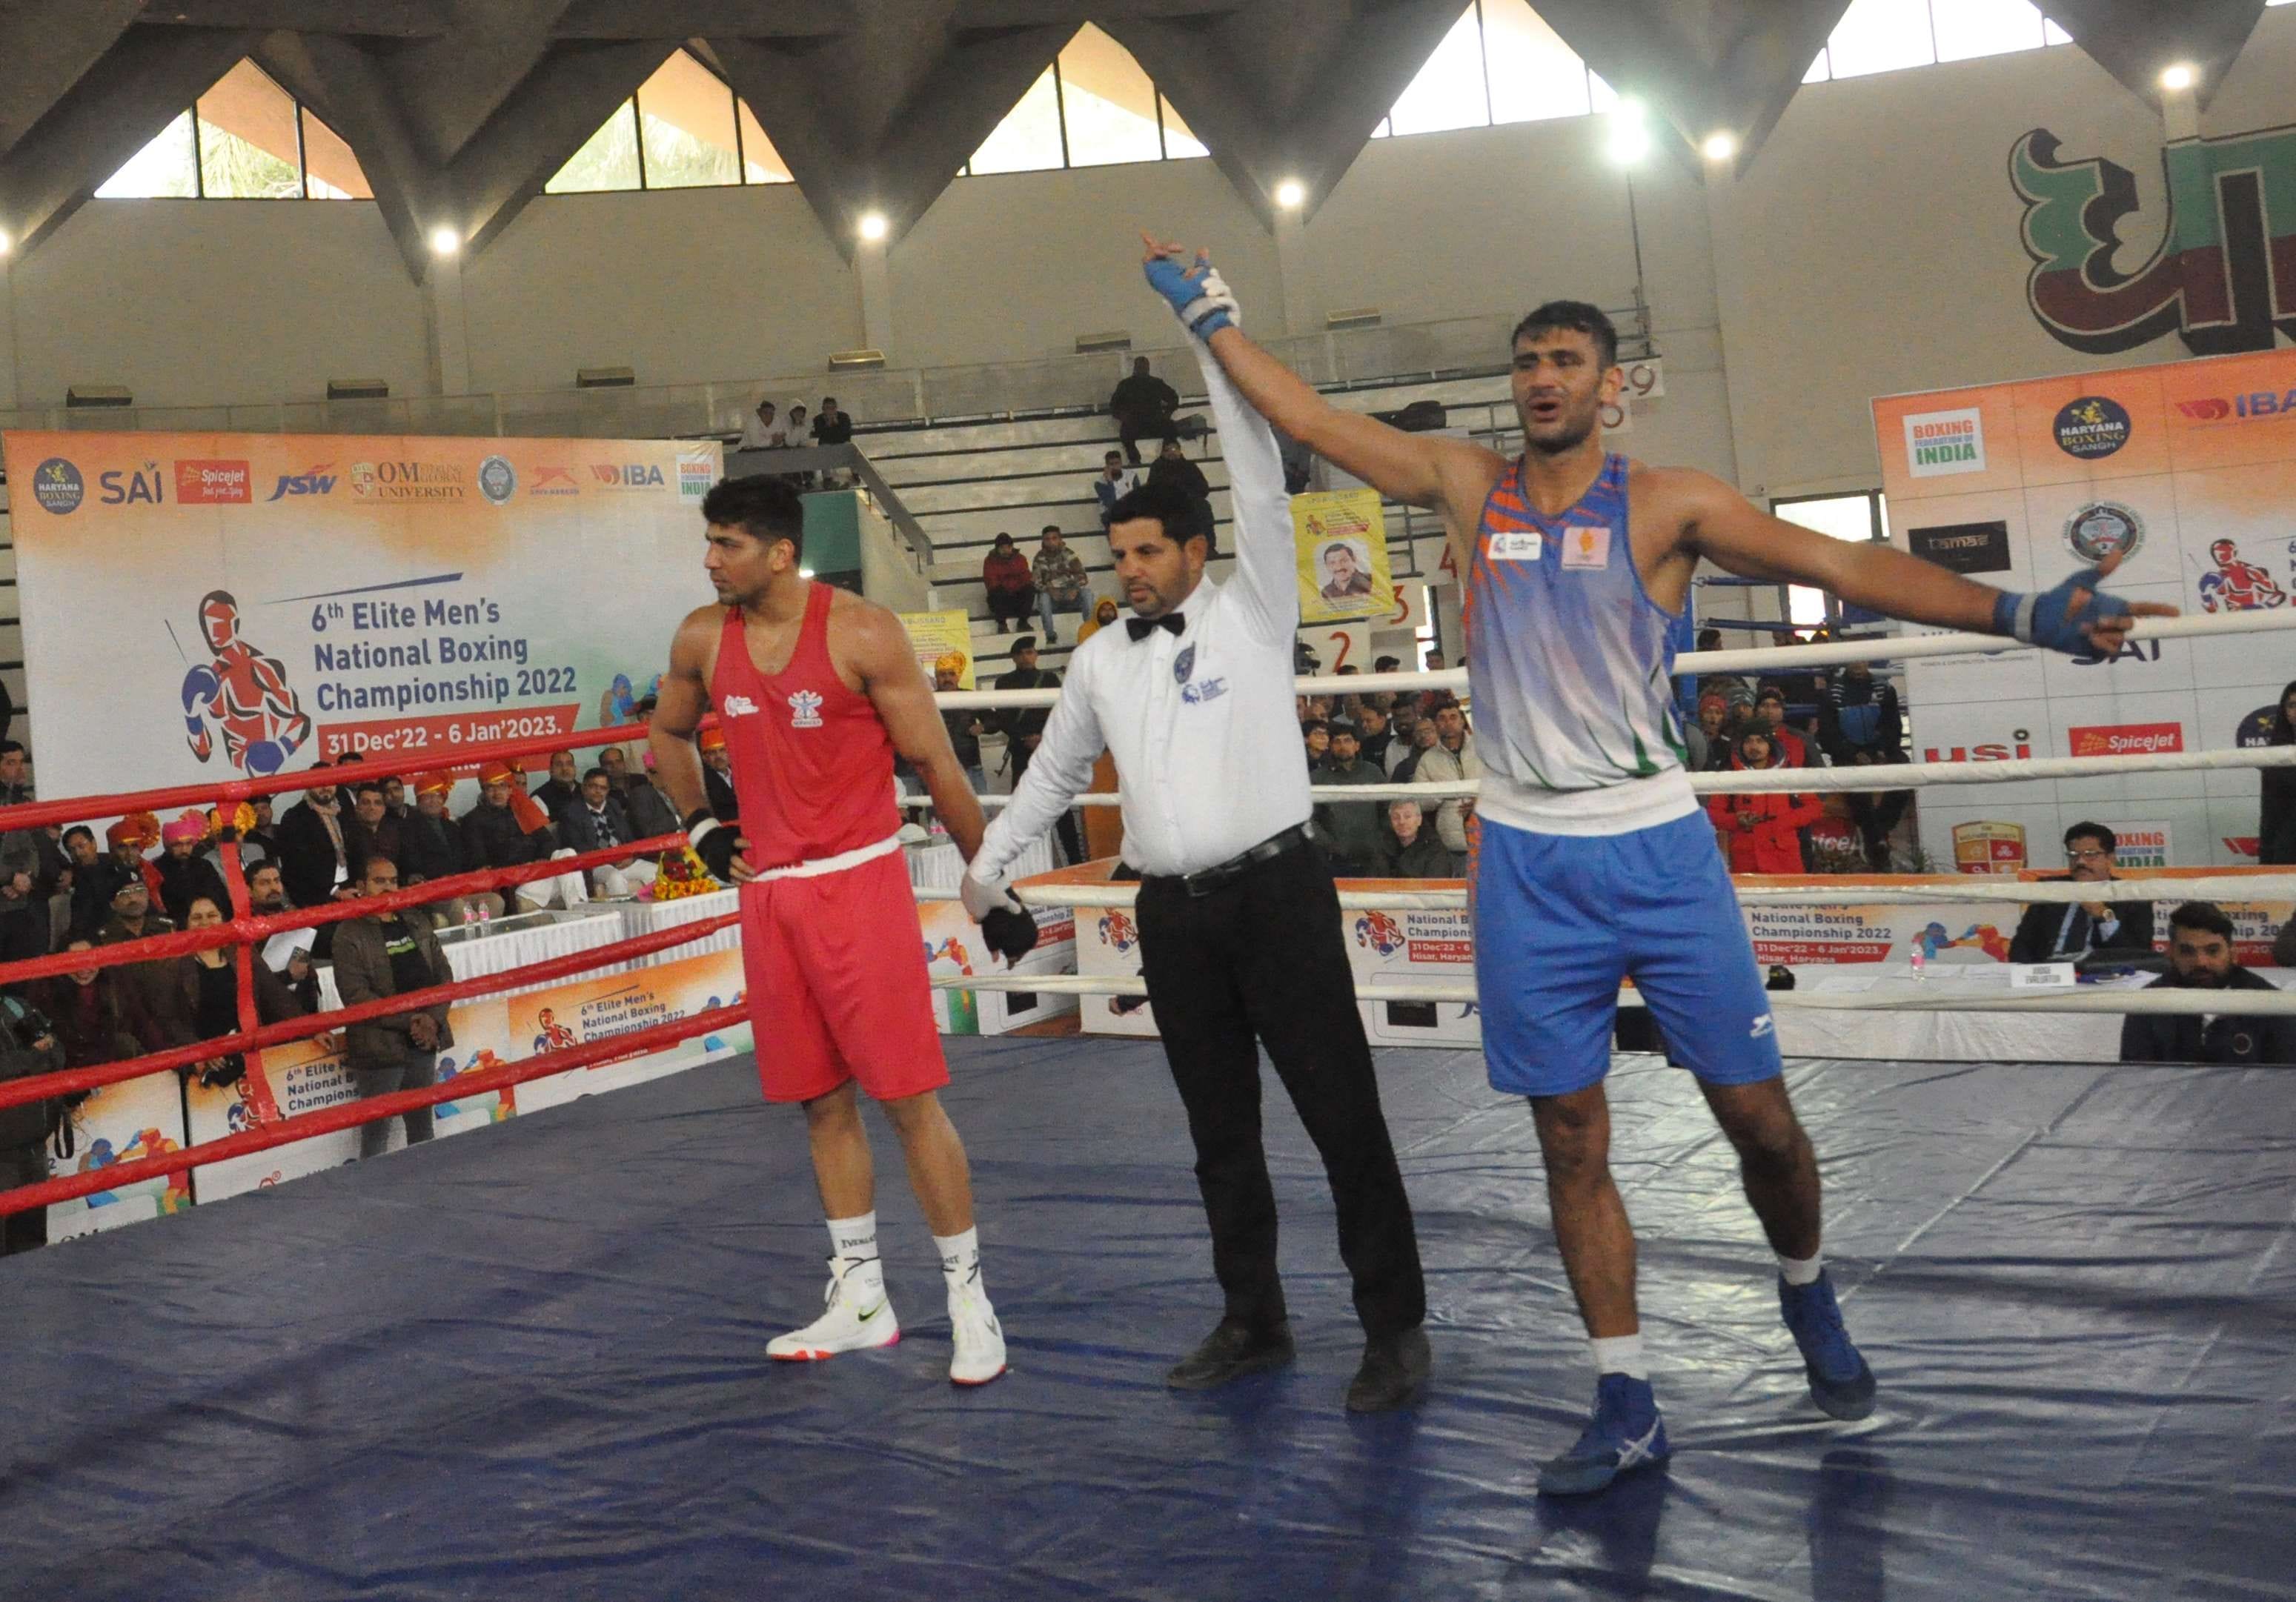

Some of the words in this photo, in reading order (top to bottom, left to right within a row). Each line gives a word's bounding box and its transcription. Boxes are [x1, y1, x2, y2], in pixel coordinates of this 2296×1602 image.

[1630, 364, 1656, 396] 9
[1913, 419, 1974, 439] BOXING
[2060, 422, 2124, 436] HARYANA
[2063, 433, 2126, 446] BOXING
[2072, 442, 2117, 453] SANGH
[1916, 443, 1977, 465] INDIA
[201, 469, 245, 486] SpiceJet
[378, 462, 419, 483] OM
[623, 465, 665, 485] IBA
[39, 483, 79, 491] HARYANA
[39, 491, 80, 499] BOXING
[265, 475, 338, 502] JSW
[379, 486, 465, 497] UNIVERSITY
[1438, 542, 1458, 578] 4
[311, 602, 343, 632] 6th
[352, 602, 416, 629] Elite
[425, 597, 500, 626] Men's
[314, 639, 431, 671] National
[440, 637, 528, 665] Boxing
[1329, 631, 1351, 673] 2
[2071, 639, 2160, 665] AI
[317, 671, 510, 711] Championship
[517, 667, 577, 696] 2022
[327, 734, 349, 754] 31
[448, 723, 461, 743] 6
[2108, 734, 2175, 754] SpiceJet
[2115, 832, 2165, 846] OXING
[2115, 855, 2165, 868] NDIA
[1407, 914, 1457, 924] National
[1752, 912, 1811, 923] National
[1815, 914, 1863, 925] Boxing
[1408, 926, 1472, 939] Champions
[1752, 925, 1853, 940] Championship
[1857, 928, 1891, 939] 2022
[1411, 943, 1421, 951] 31
[1439, 952, 1473, 962] Haryan
[1757, 943, 1768, 952] 31
[1818, 945, 1825, 954] 6
[581, 1003, 594, 1016] 6th
[597, 1000, 622, 1012] Elite
[624, 991, 655, 1006] Men's
[583, 1010, 628, 1029] National
[630, 1003, 666, 1018] Boxing
[583, 1018, 659, 1043] Championship
[660, 1009, 686, 1025] 2022
[286, 1068, 302, 1081] 6th
[305, 1063, 335, 1077] Elite
[287, 1074, 342, 1097] National
[288, 1088, 359, 1111] Champions
